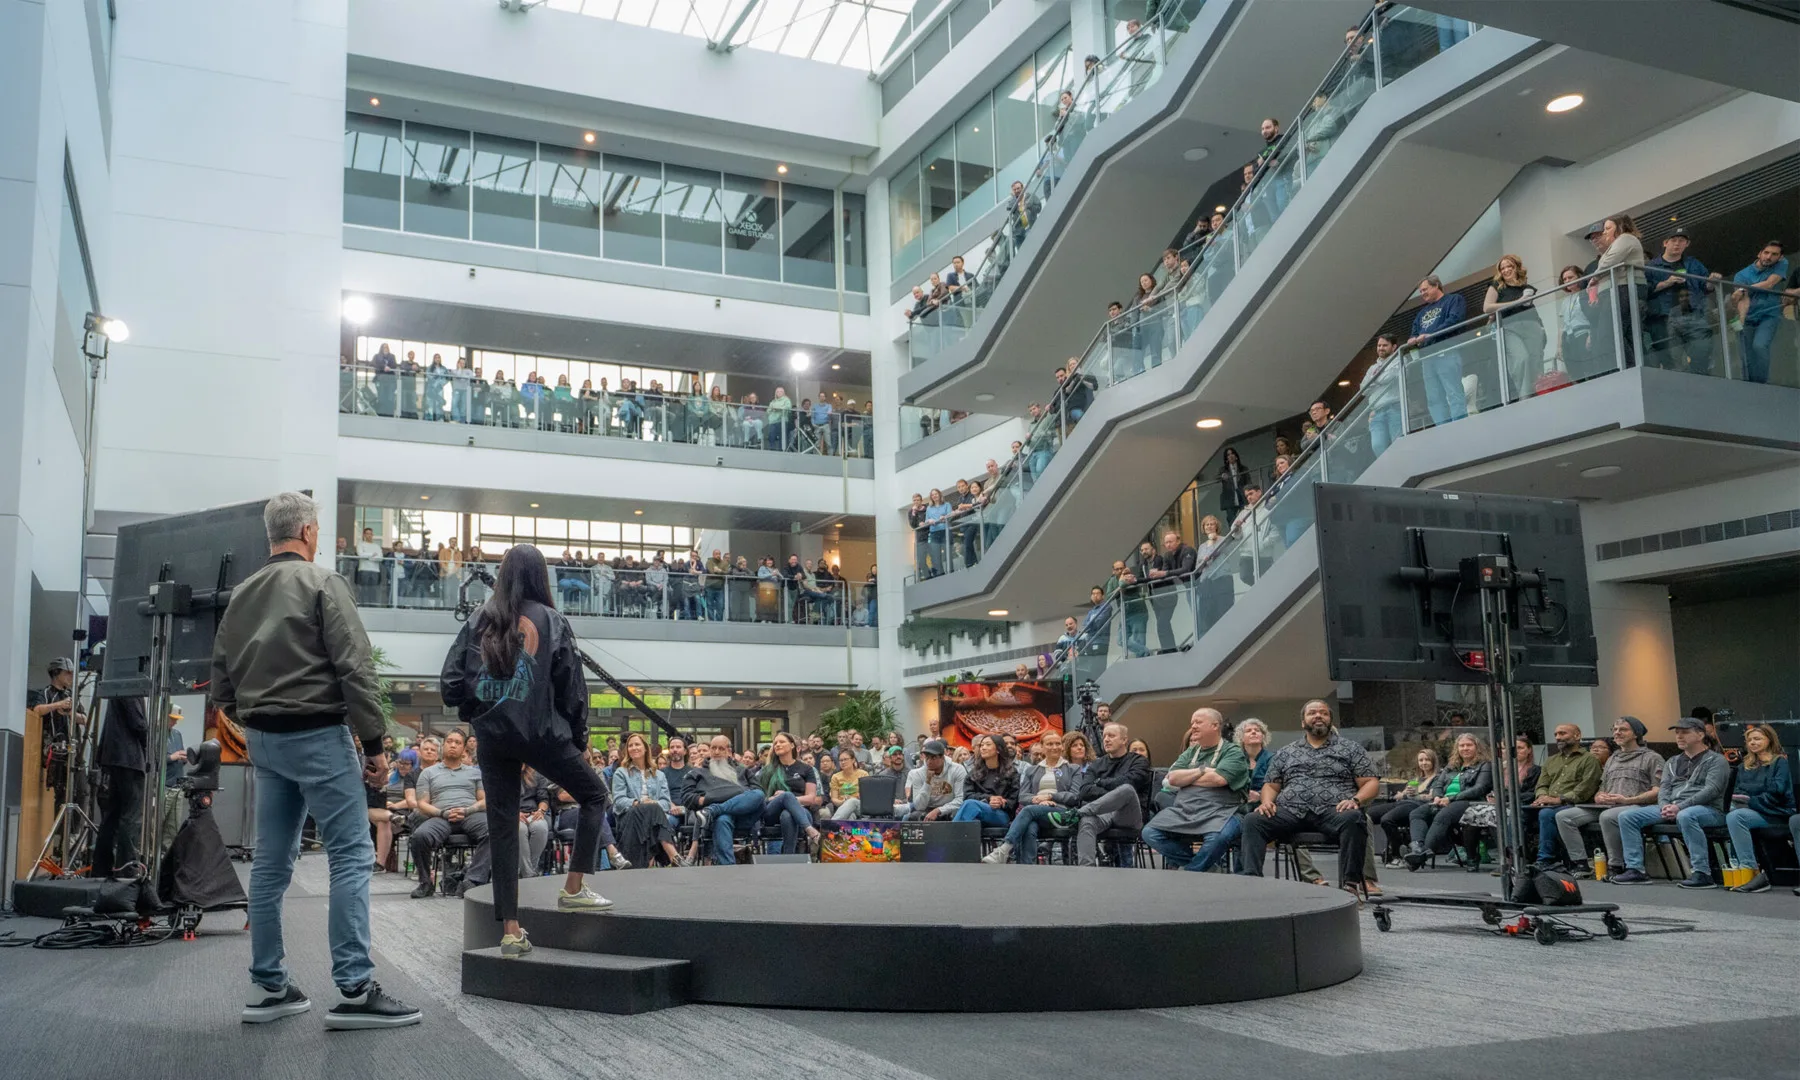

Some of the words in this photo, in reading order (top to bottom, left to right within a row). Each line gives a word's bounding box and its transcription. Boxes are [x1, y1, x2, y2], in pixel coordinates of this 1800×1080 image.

[740, 222, 763, 232] XBOX
[728, 228, 747, 237] GAME
[748, 231, 774, 240] STUDIOS
